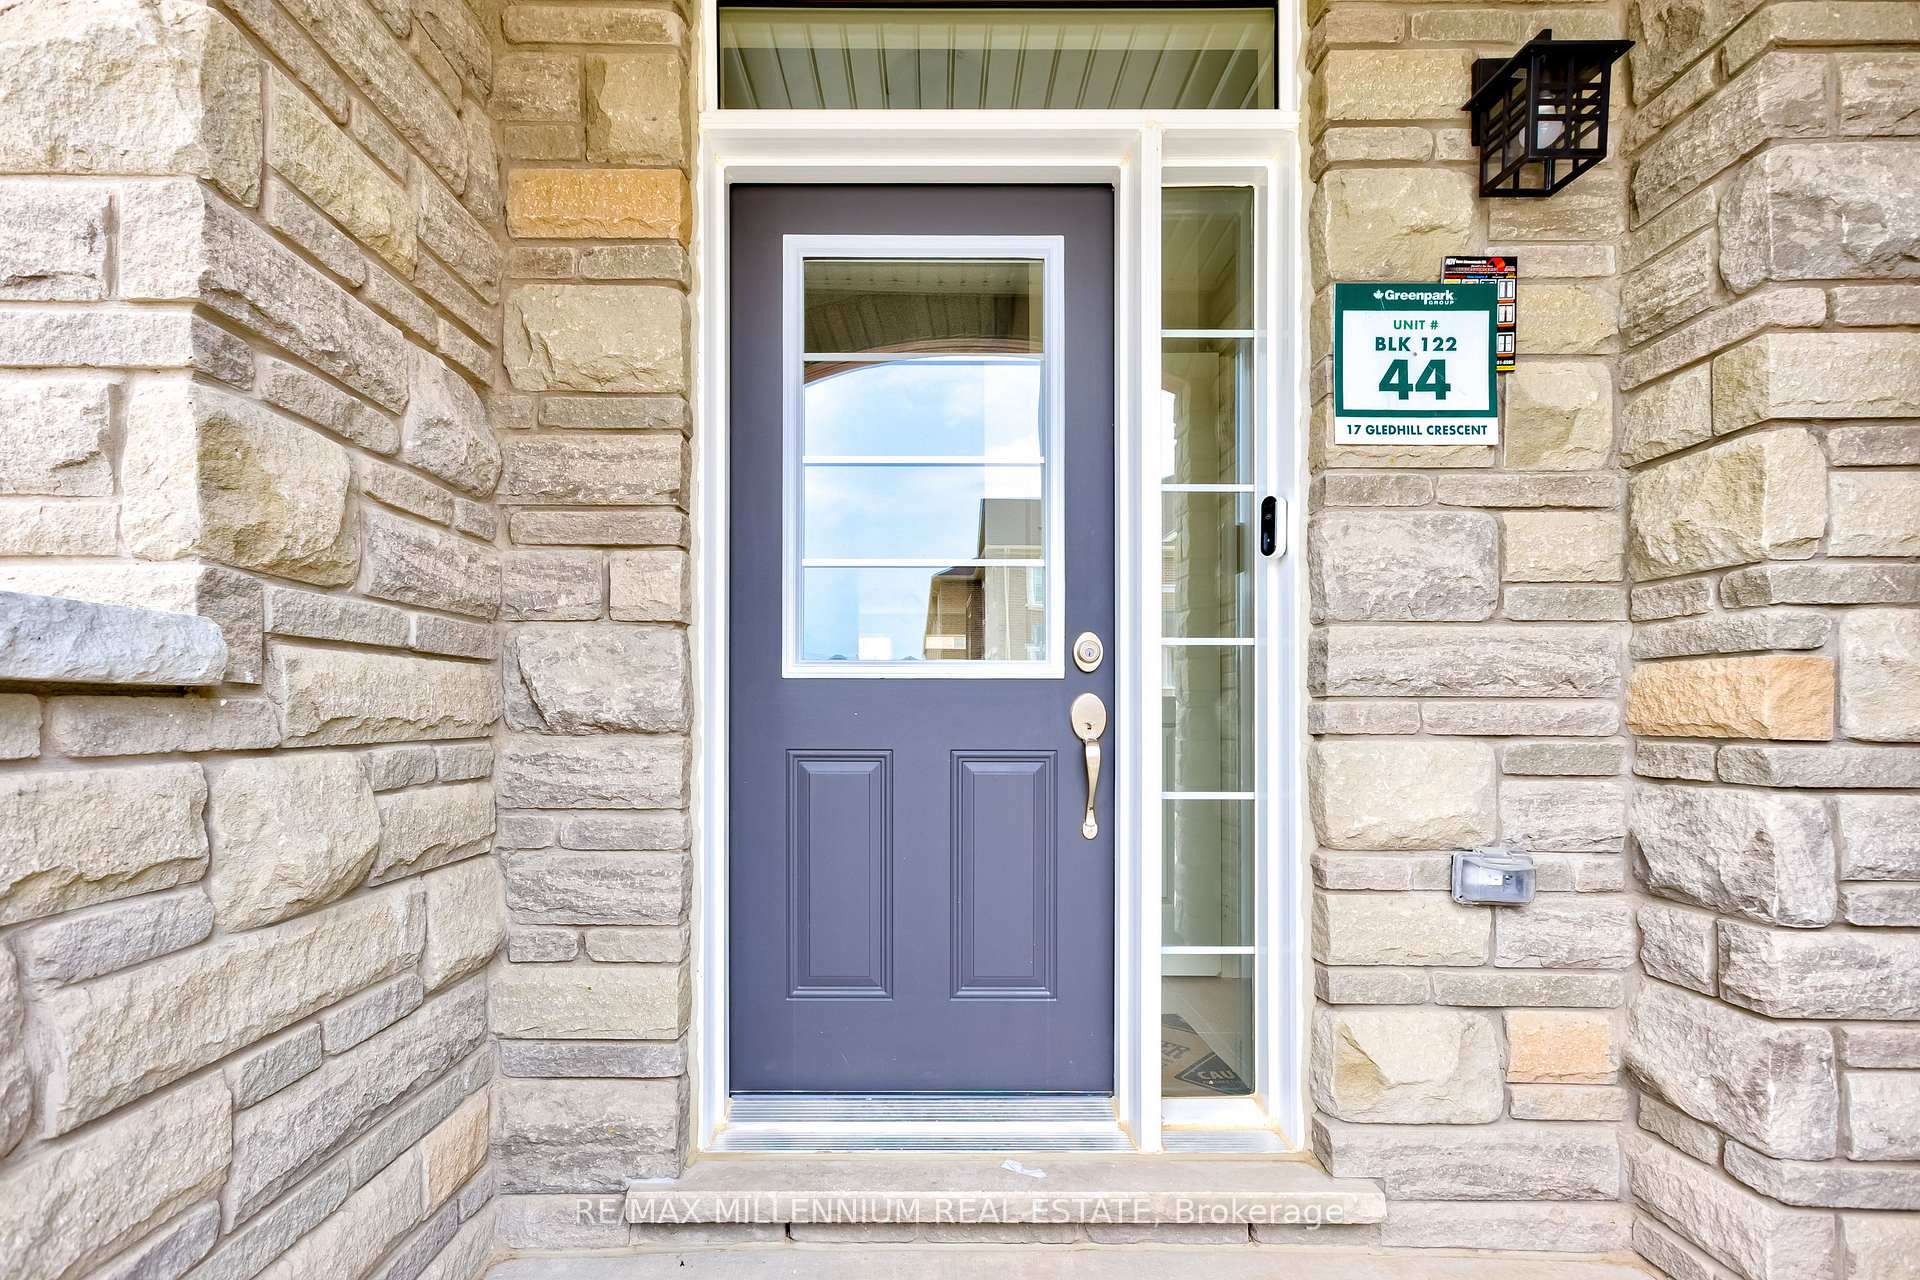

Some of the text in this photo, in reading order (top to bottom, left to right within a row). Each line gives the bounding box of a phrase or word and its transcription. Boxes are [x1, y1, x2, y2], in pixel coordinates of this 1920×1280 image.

[1384, 289, 1454, 305] Greenpark
[1393, 319, 1439, 330] UNIT #
[1375, 336, 1457, 352] BLK 122
[1378, 359, 1451, 400] 44
[1347, 424, 1488, 436] 17 GLEDHILL CRESCENT
